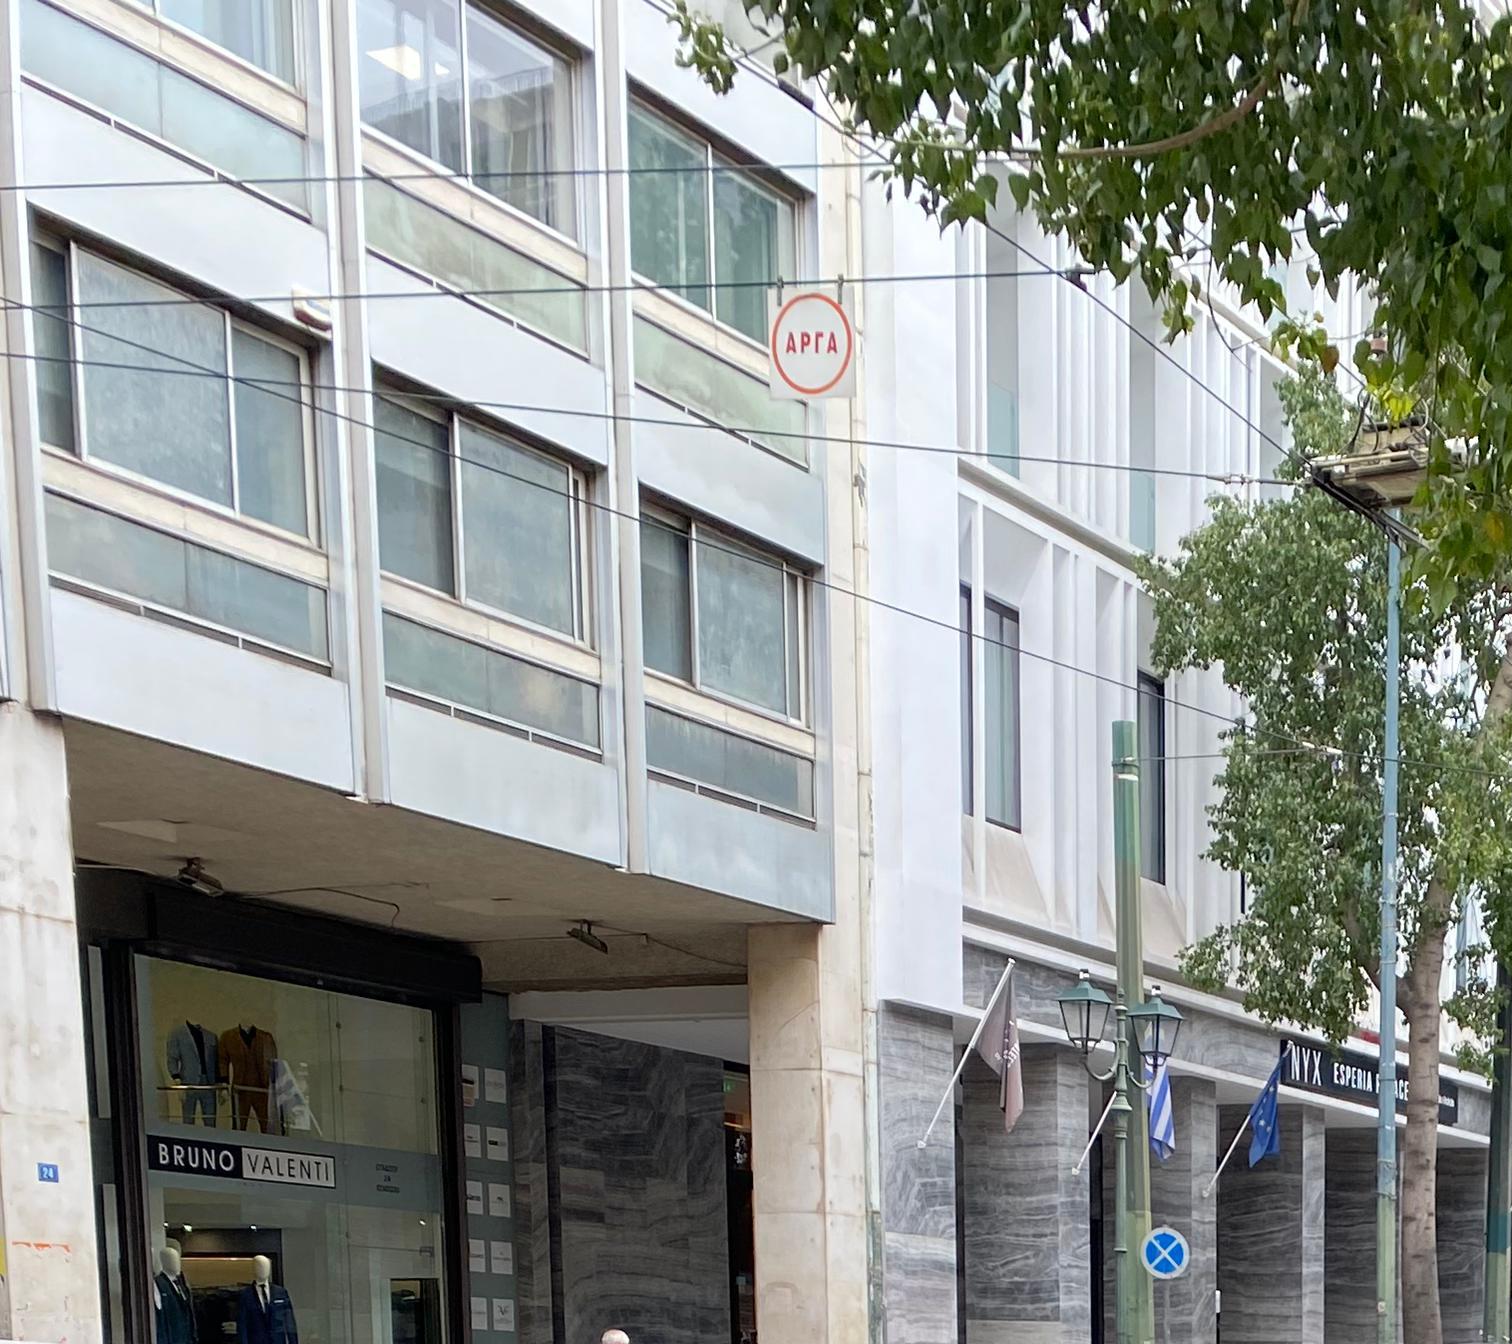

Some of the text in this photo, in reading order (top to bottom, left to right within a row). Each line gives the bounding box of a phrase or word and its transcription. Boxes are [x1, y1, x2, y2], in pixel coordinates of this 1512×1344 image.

[786, 331, 837, 354] ΑΡΓΑ
[1291, 1045, 1321, 1086] NYX
[1333, 1062, 1373, 1092] ESPERIA
[158, 1143, 330, 1181] BRUNO VALENTI
